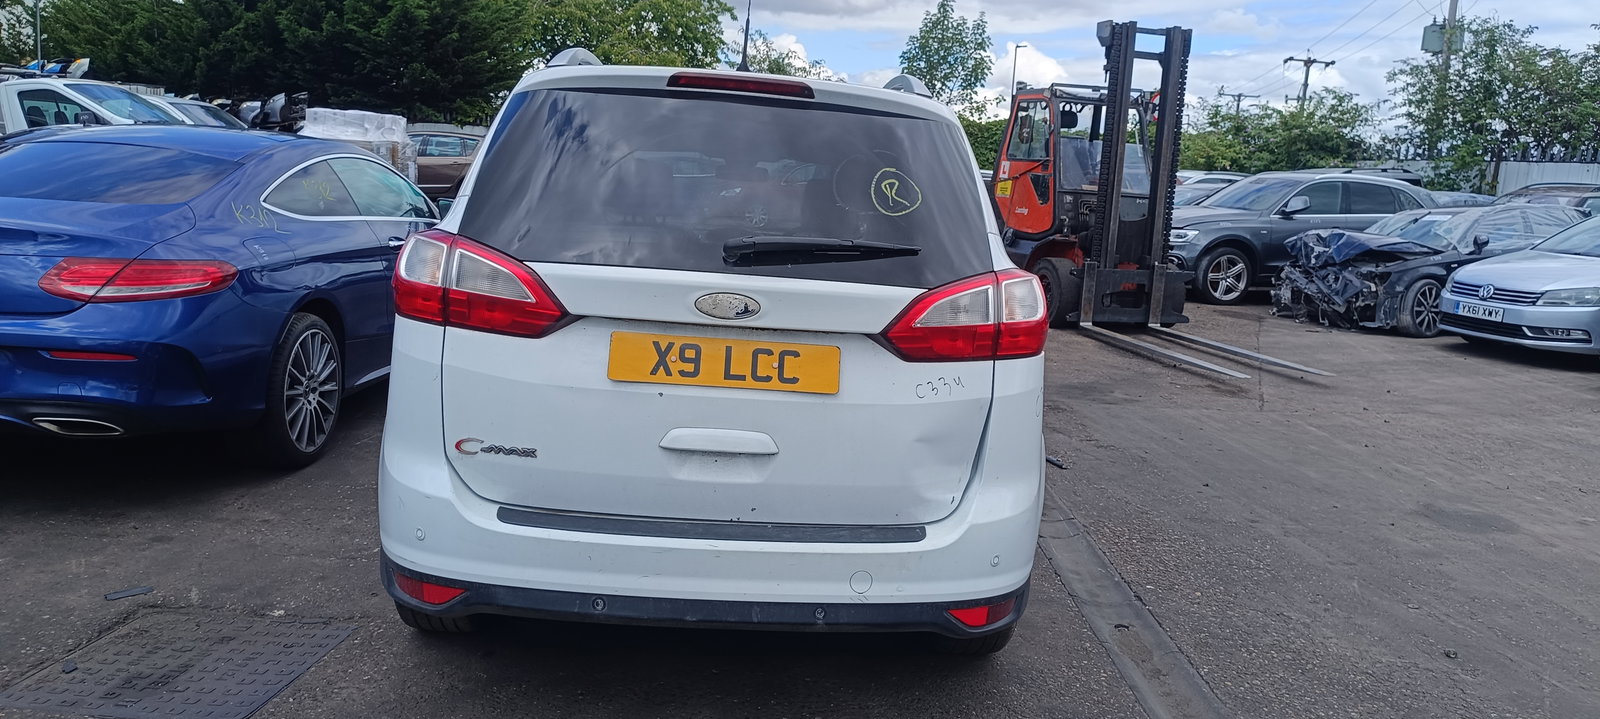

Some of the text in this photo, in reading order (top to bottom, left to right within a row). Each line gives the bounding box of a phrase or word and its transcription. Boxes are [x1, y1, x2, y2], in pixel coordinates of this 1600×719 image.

[881, 179, 911, 206] R
[1461, 303, 1500, 319] YX61 XWY
[649, 340, 801, 385] X9 LCC
